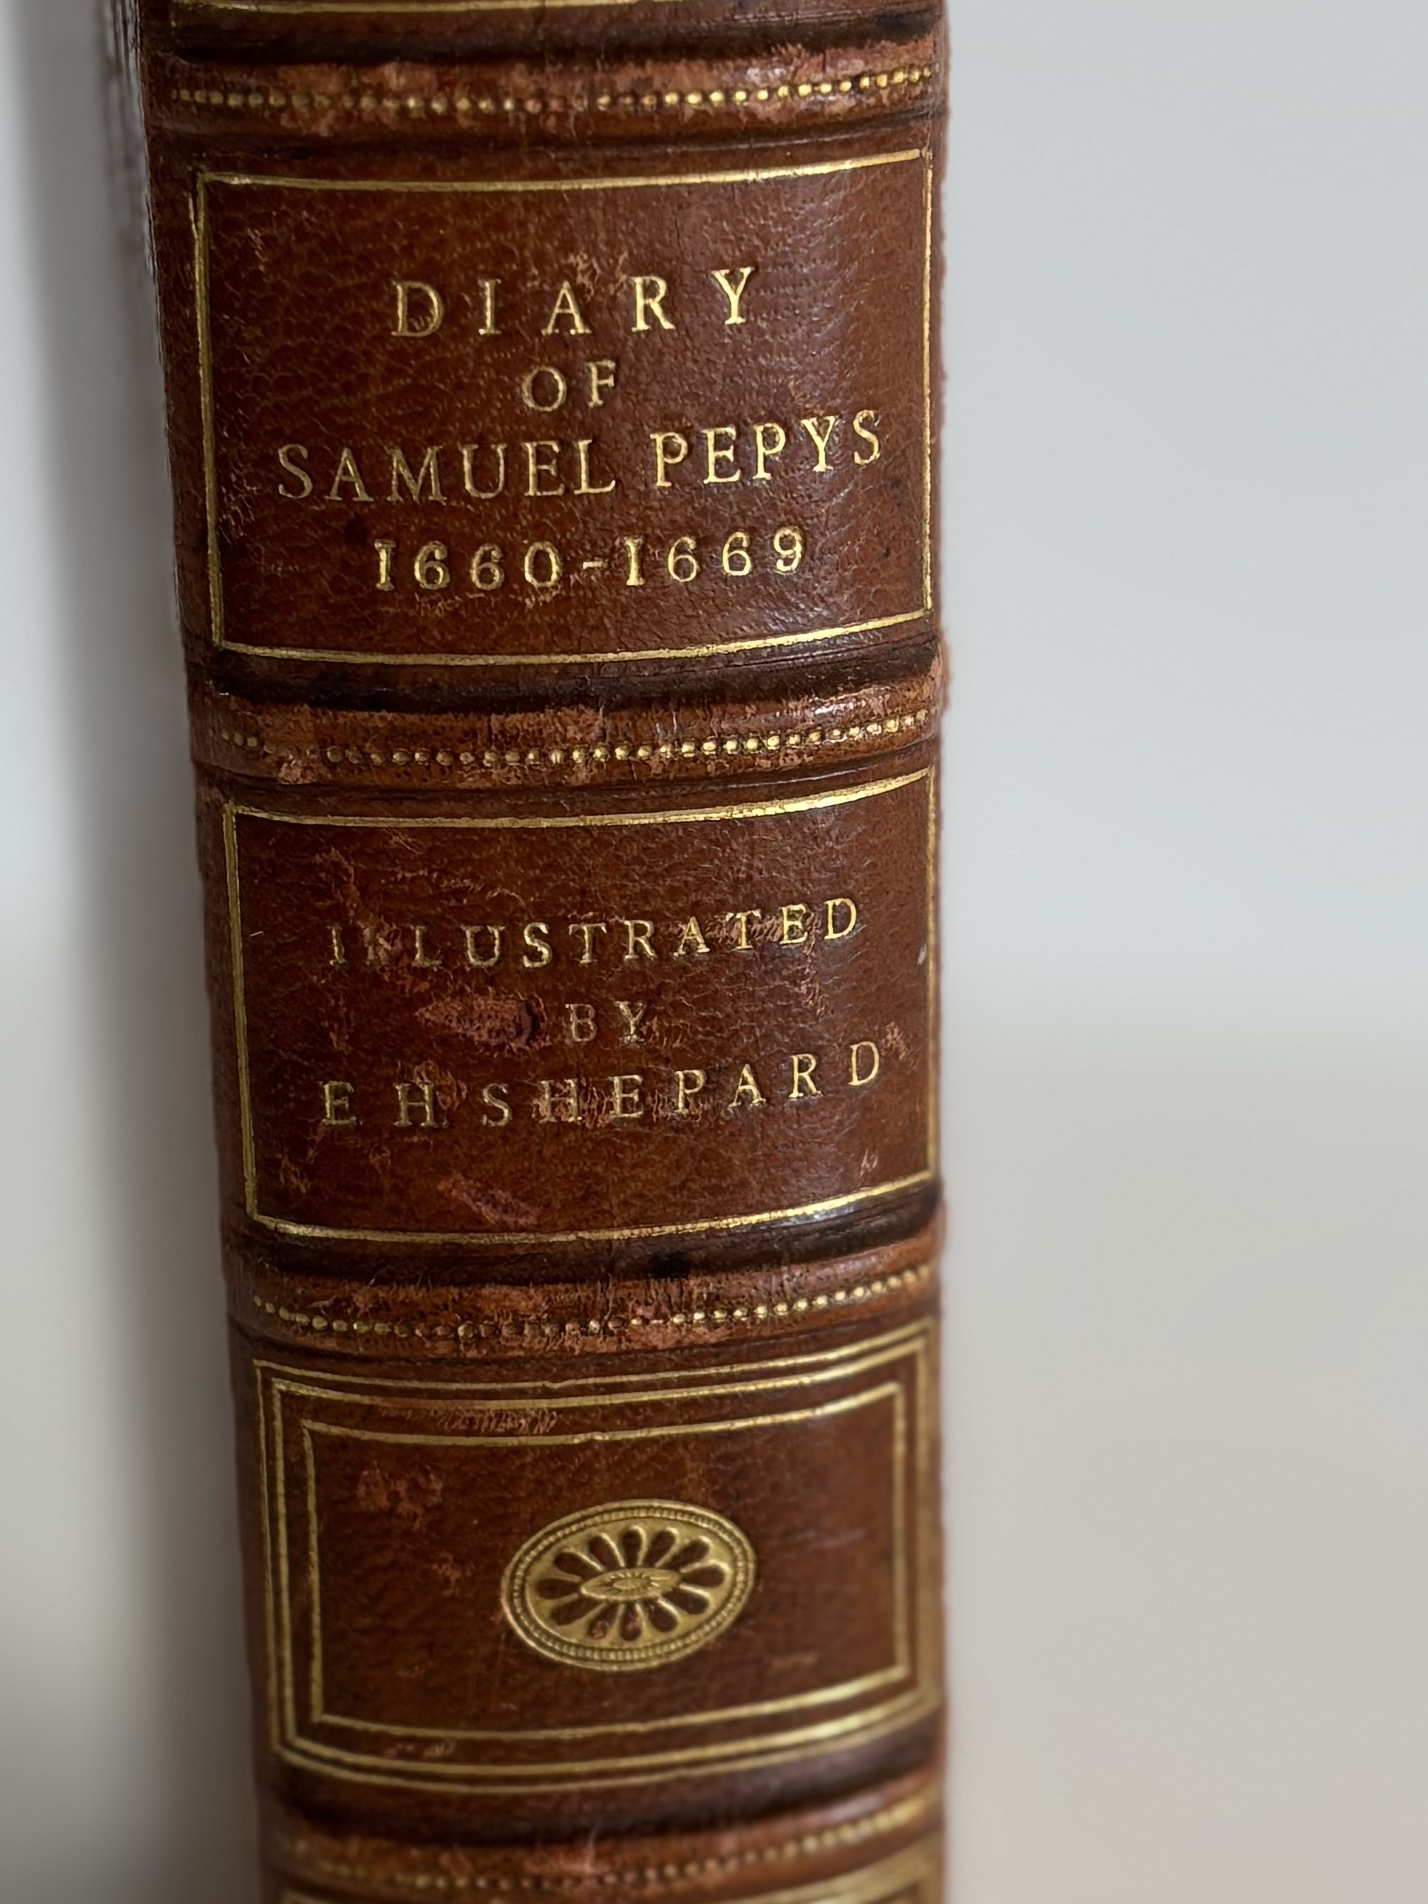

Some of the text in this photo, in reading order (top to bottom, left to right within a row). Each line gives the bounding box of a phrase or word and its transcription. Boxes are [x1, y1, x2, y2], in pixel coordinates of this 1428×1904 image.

[390, 265, 756, 338] DIARY
[520, 358, 619, 413] OF
[276, 408, 883, 502] SAMUEL PEPYS
[374, 526, 804, 592] 1660-1669
[565, 1000, 646, 1044] BY
